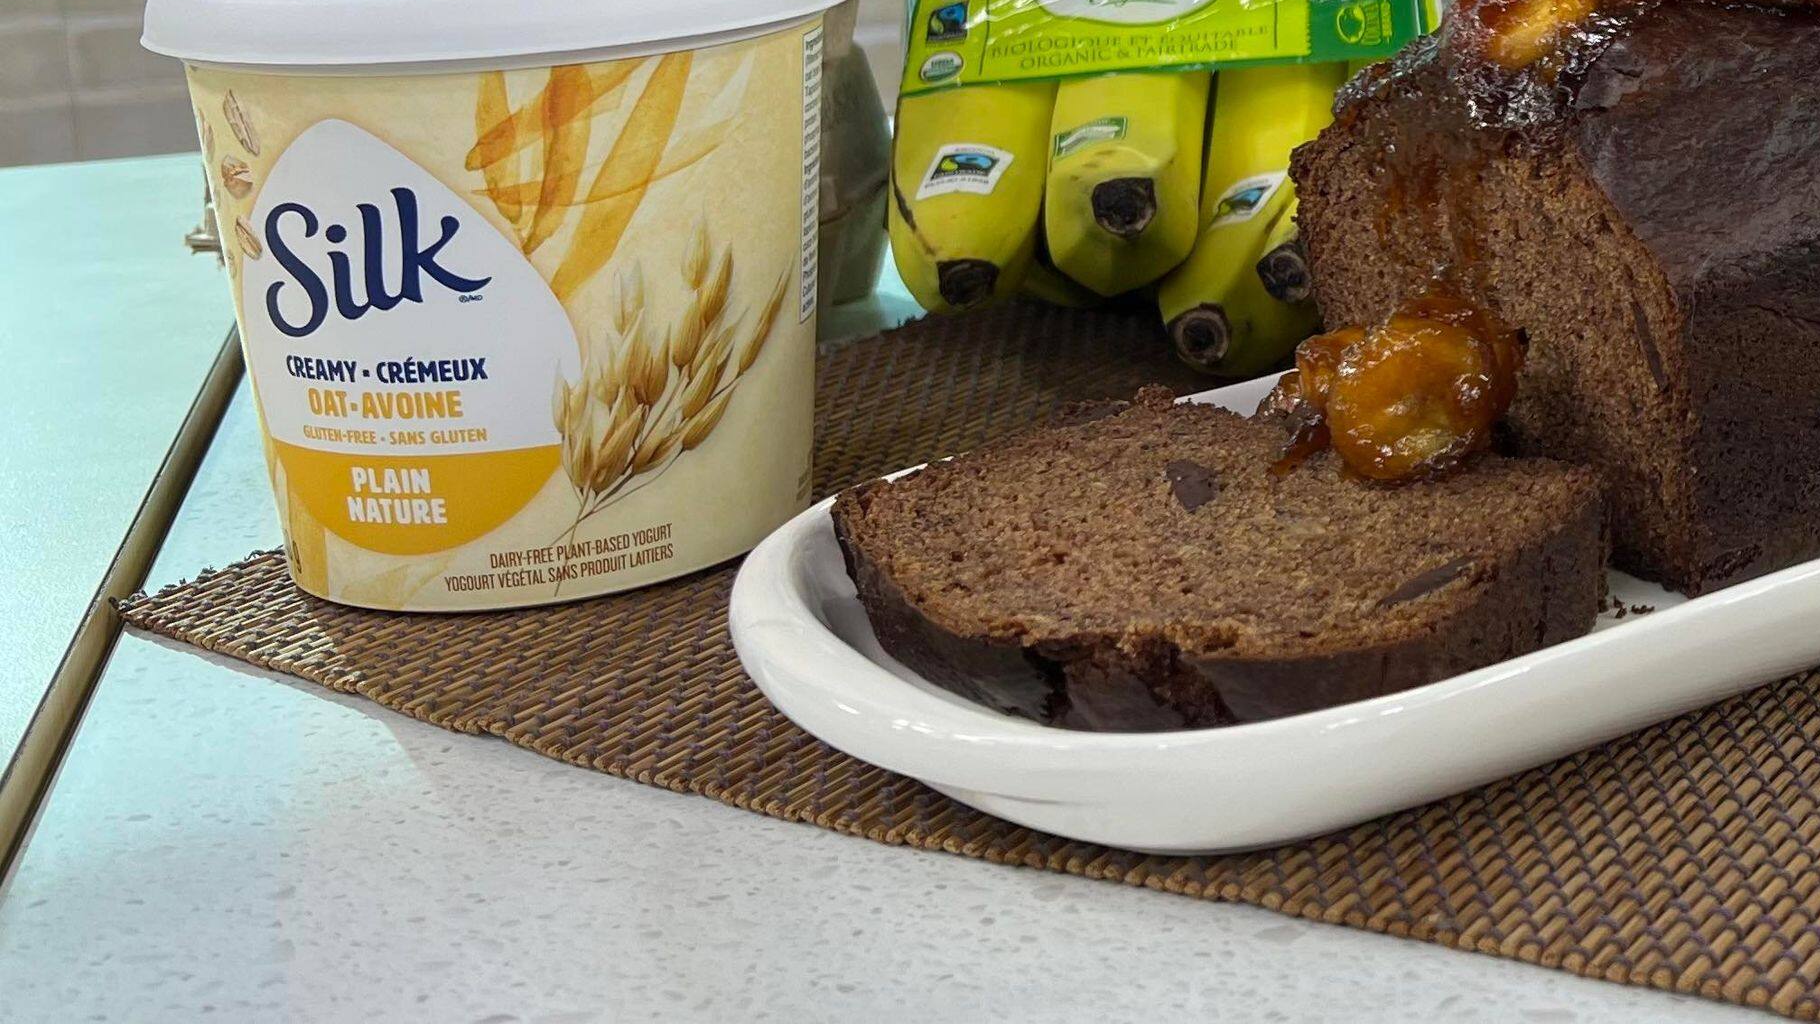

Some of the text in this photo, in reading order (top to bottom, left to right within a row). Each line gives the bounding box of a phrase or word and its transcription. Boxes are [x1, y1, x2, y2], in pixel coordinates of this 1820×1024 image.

[1019, 47, 1106, 71] ORGANIC
[1136, 38, 1239, 59] FAIRTRADE
[264, 187, 493, 339] Silk
[286, 355, 488, 384] CREAMY CRÉMEUX
[308, 387, 464, 419] OAT AVOINE
[303, 425, 488, 445] GLUTEN-FREE SANS GLUTEN
[351, 466, 432, 494] PLAIN
[346, 496, 448, 524] NATURE
[490, 523, 673, 569] DAIRY-FREE PLANT-BASED YOGURT
[445, 543, 674, 592] YOGOURT VÉGÉTAL SANS PRODUIT LAITIERS
